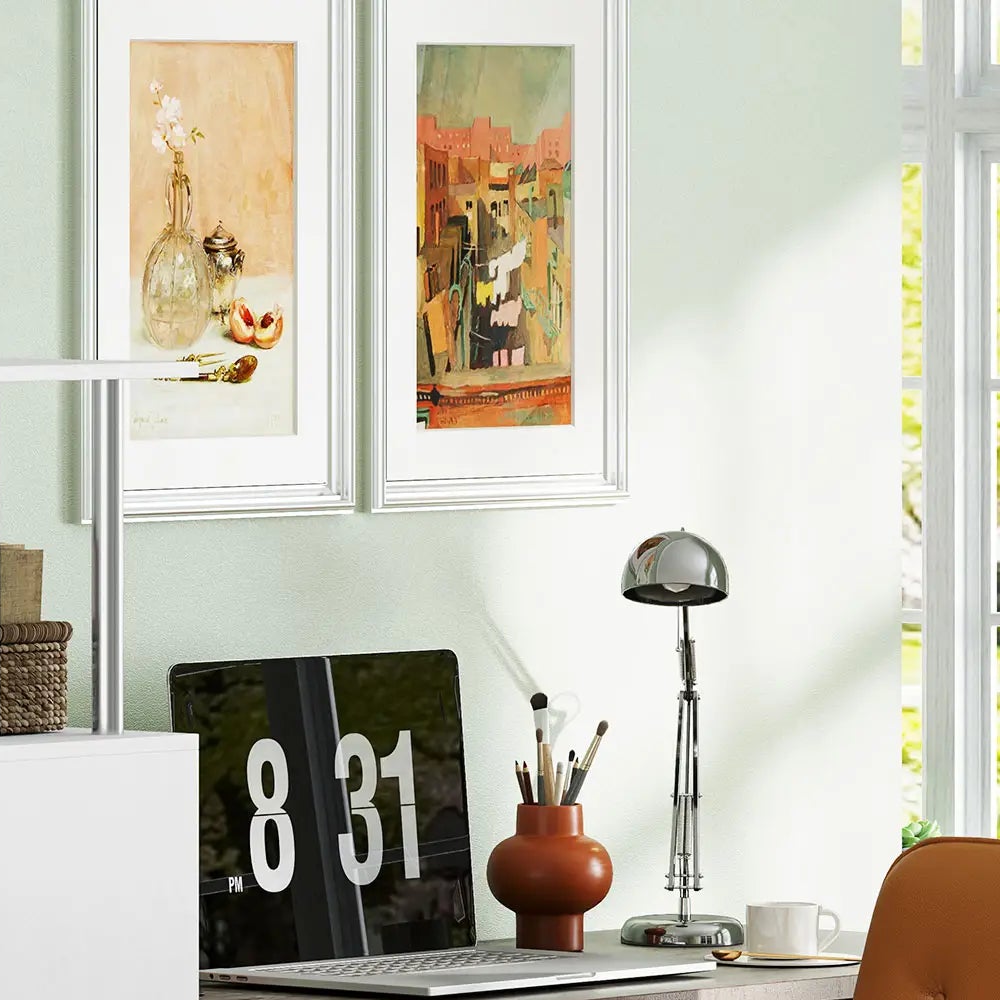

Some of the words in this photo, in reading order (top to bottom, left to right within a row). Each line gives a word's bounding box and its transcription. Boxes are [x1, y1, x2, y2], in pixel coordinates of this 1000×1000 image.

[246, 738, 295, 893] 8
[334, 730, 421, 886] 31
[228, 876, 243, 893] PM
